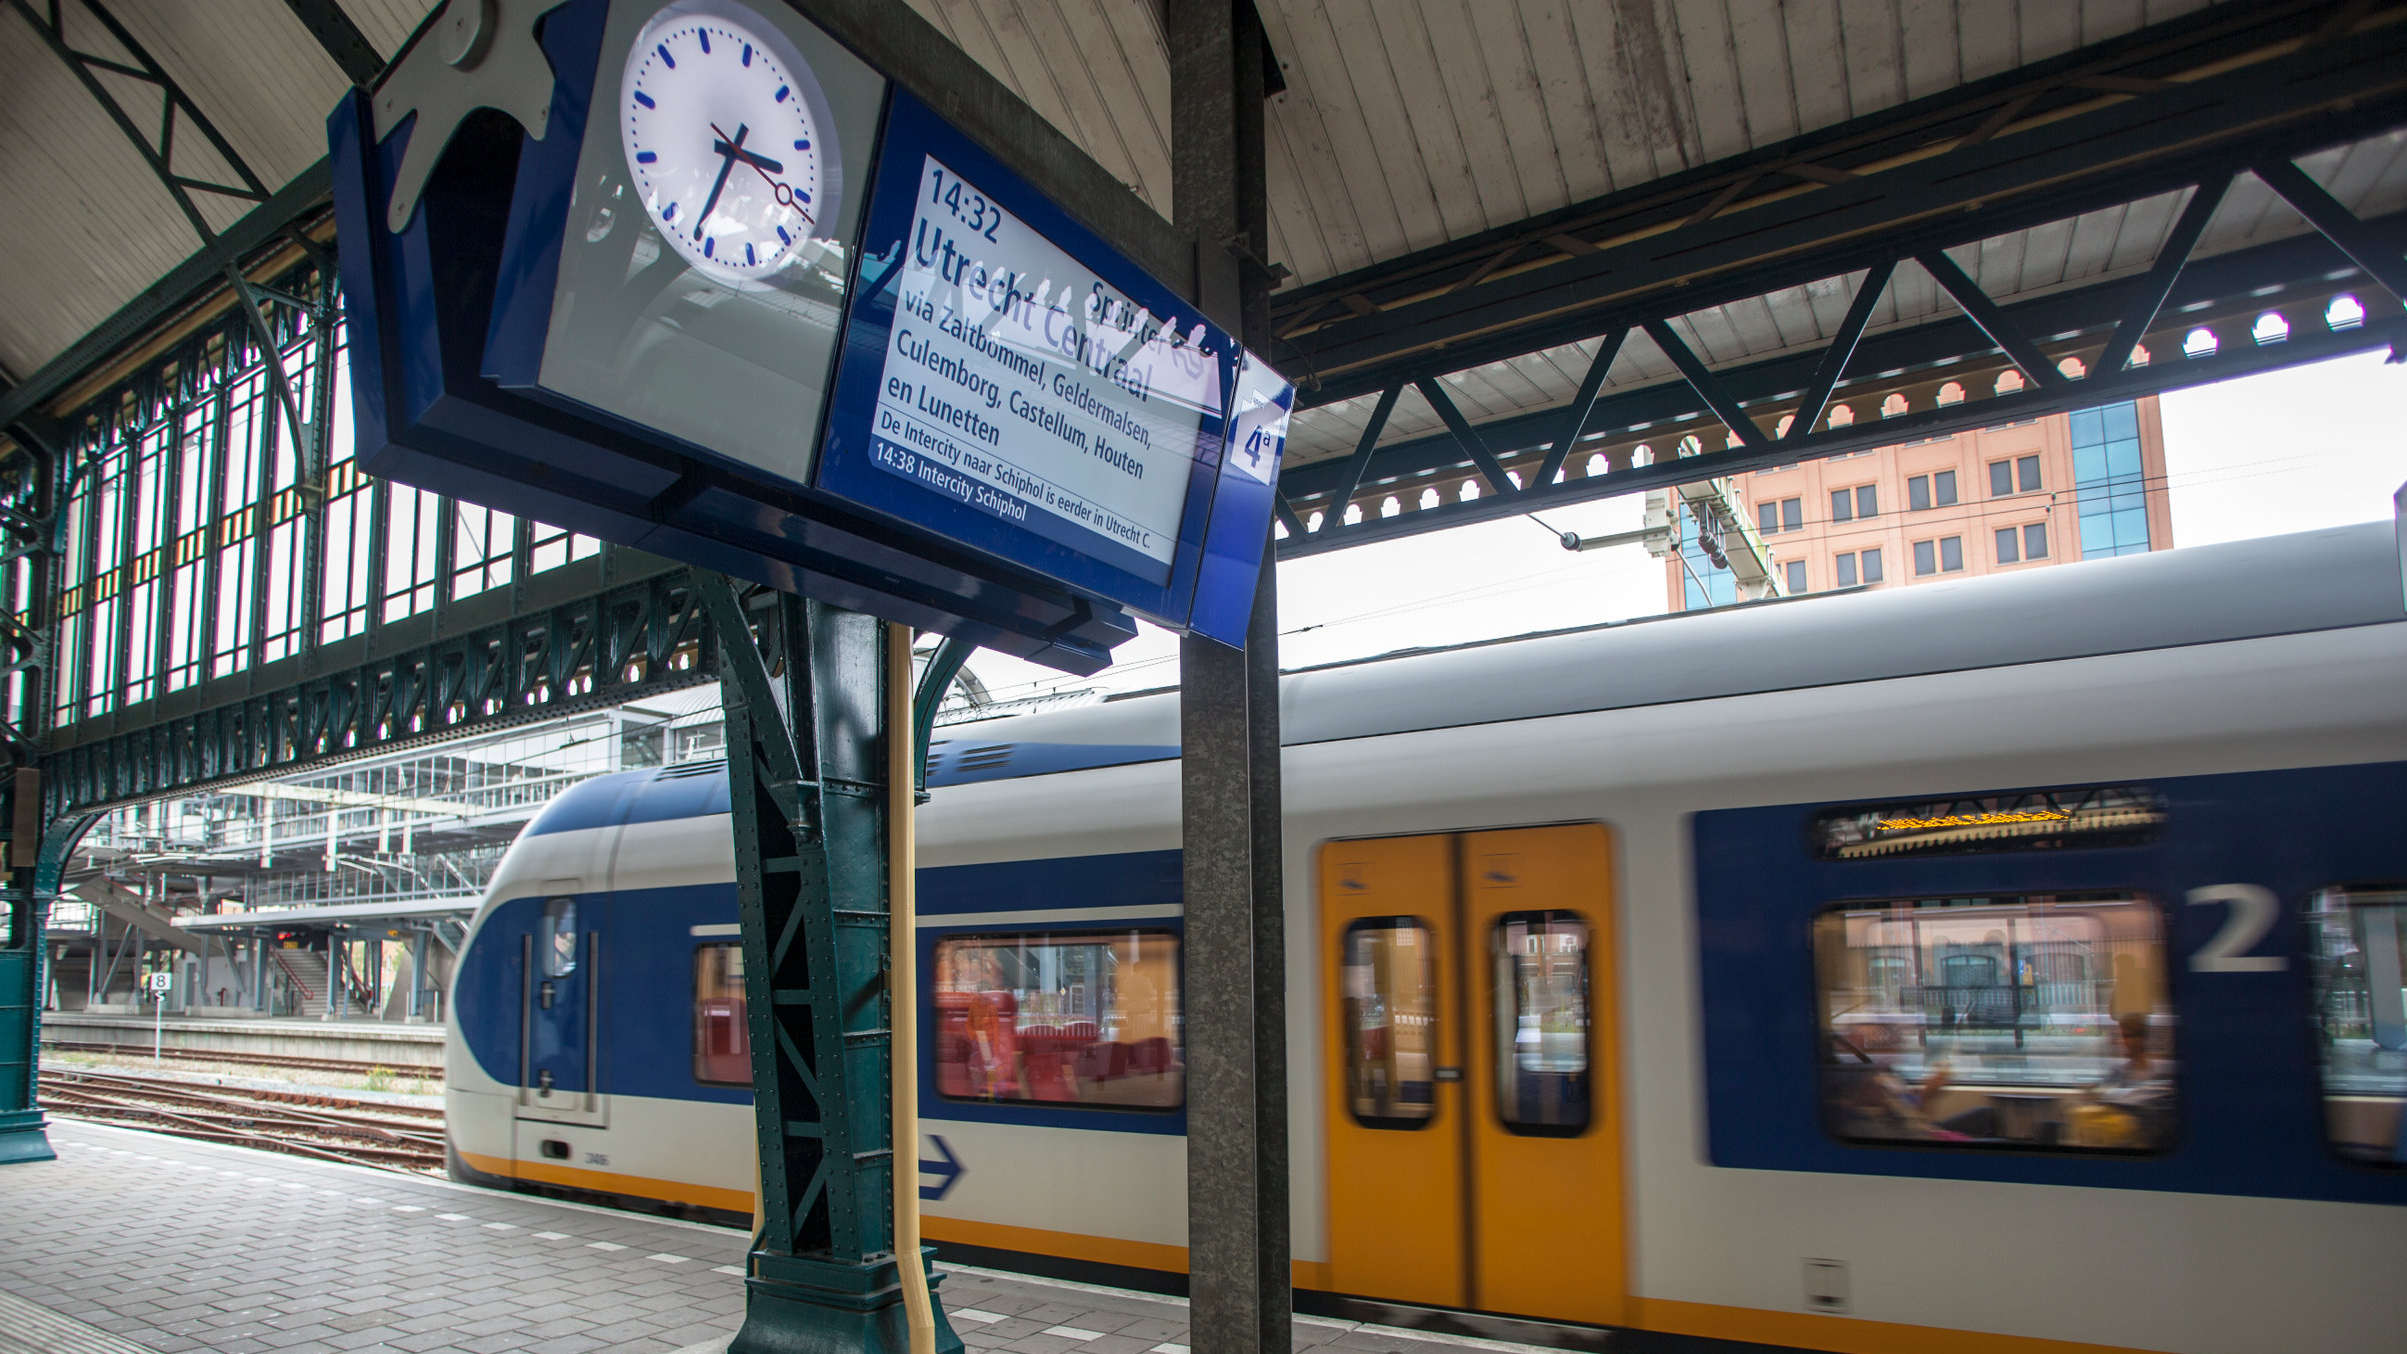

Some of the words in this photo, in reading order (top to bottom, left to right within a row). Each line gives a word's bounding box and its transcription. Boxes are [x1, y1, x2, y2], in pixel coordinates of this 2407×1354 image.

[932, 169, 1001, 244] 14:32
[916, 217, 1036, 332] Utrecht
[1044, 305, 1153, 403] Centraal
[1090, 281, 1166, 355] Sprinter
[888, 377, 912, 404] en
[918, 385, 999, 446] Lunetten
[897, 329, 1001, 408] Culemborg,
[1010, 390, 1088, 454] Castellum,
[1094, 435, 1143, 480] Houten
[906, 290, 934, 323] via
[939, 306, 1046, 391] Zaltbommel,
[1053, 373, 1151, 450] Geldermalsen,
[878, 442, 915, 473] 14:38
[918, 460, 974, 502] Intercity
[975, 486, 1027, 521] Schiphol
[881, 411, 900, 435] De
[905, 422, 961, 465] Intercity
[964, 453, 992, 476] naar
[994, 464, 1044, 499] Schiphol
[1046, 487, 1055, 505] is
[1057, 496, 1092, 522] eerder
[1094, 509, 1103, 528] in
[1106, 515, 1141, 544] Utrecht
[1143, 533, 1150, 548] C.
[2185, 883, 2289, 972] 2
[156, 975, 166, 988] 8
